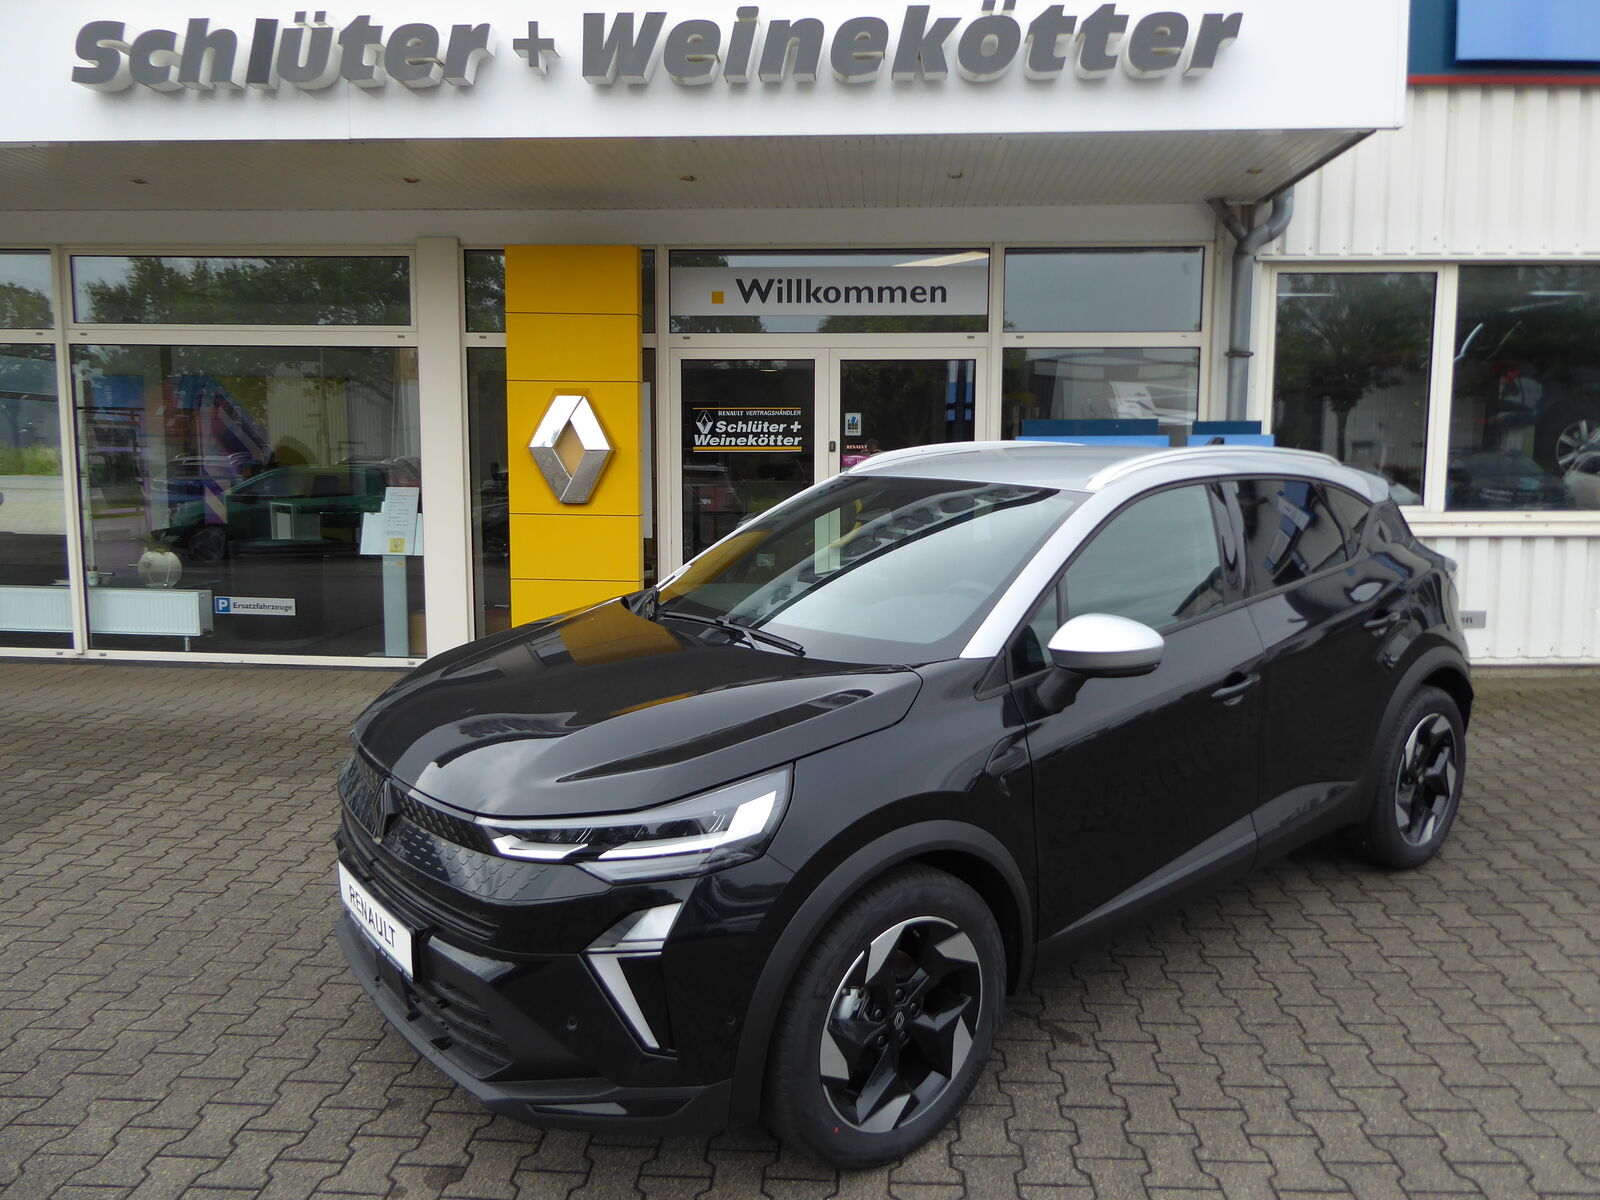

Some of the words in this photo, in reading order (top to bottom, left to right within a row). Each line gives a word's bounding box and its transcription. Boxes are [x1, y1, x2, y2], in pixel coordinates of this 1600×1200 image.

[72, 11, 493, 90] Schlüter
[582, 0, 1243, 84] Weinekötter
[735, 278, 947, 304] Willkommen
[715, 420, 787, 433] Schlüter
[693, 434, 803, 446] Weinekötter
[232, 601, 294, 612] Ersatzfahrzeuge
[348, 883, 396, 949] RENAULT
